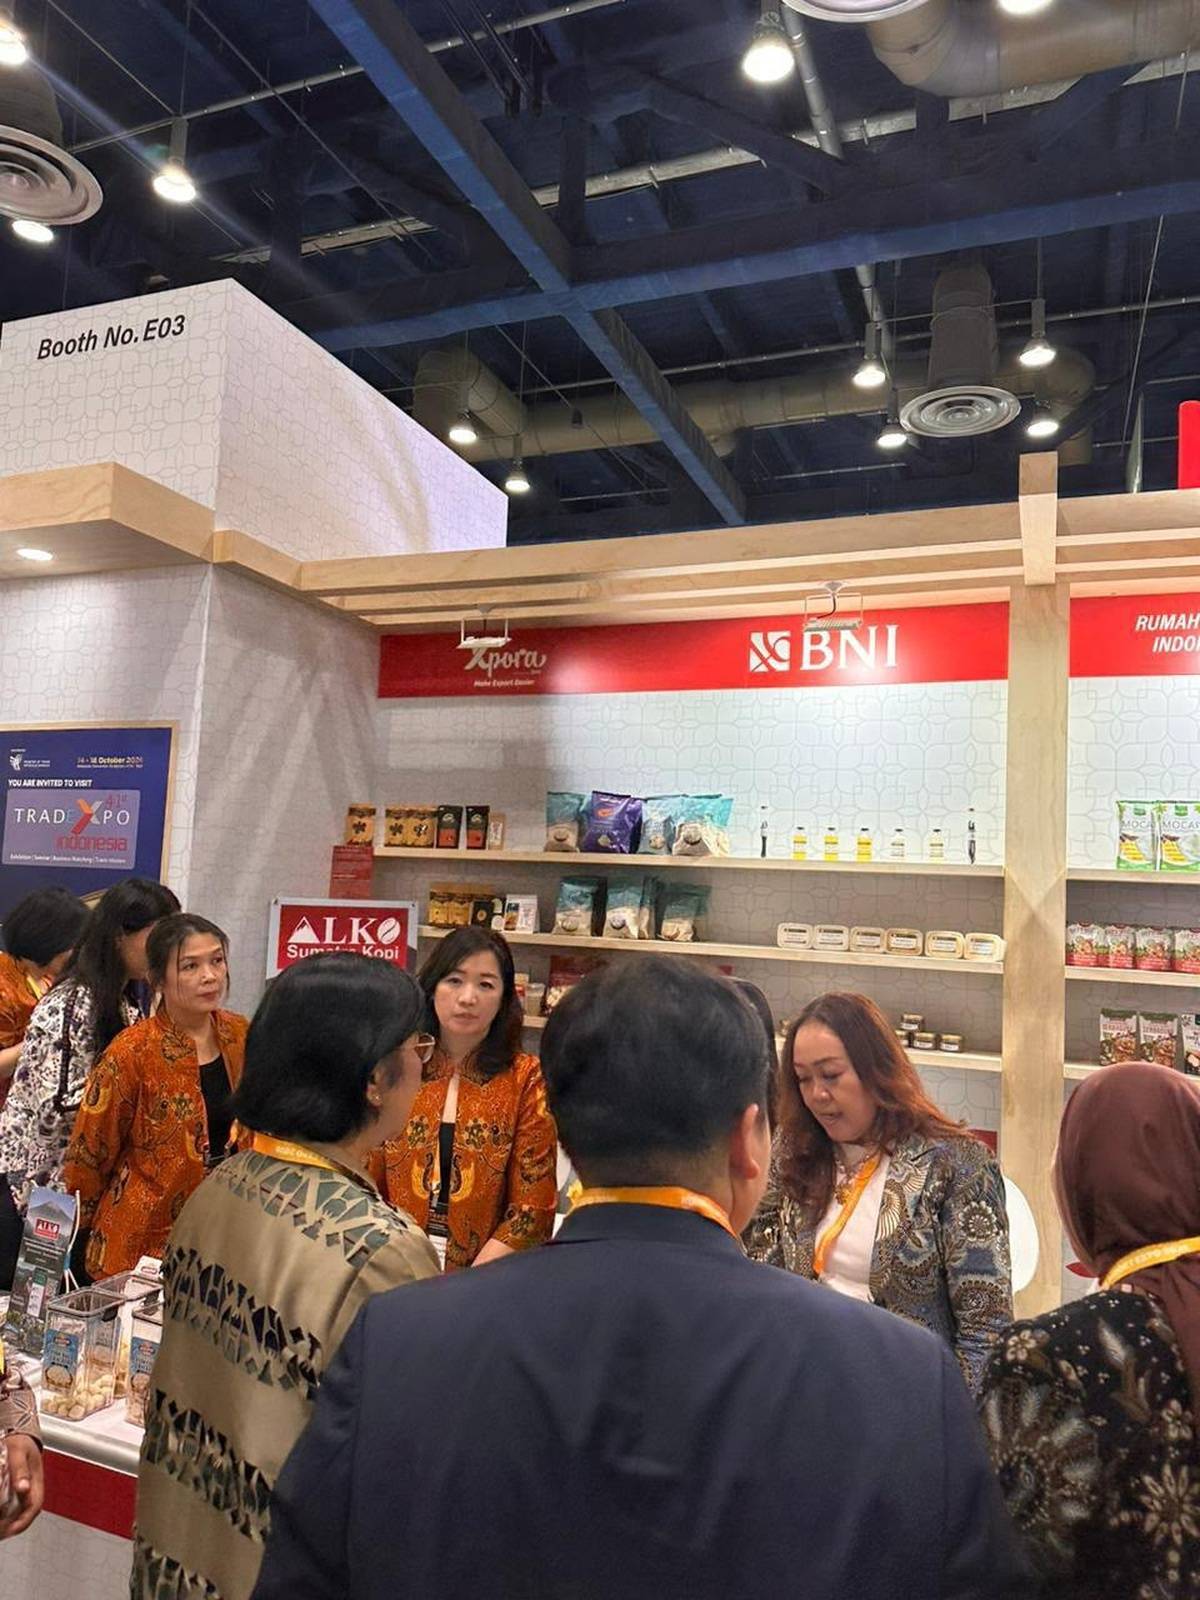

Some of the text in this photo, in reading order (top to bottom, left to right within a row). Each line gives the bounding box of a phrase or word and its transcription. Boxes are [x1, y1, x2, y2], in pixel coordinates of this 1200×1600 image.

[37, 314, 186, 360] Booth No. E03
[1135, 612, 1200, 632] RUMAH
[800, 623, 899, 671] BNI
[464, 647, 547, 678] Xpora
[98, 756, 125, 765] October
[8, 779, 93, 787] YOU ARE INVITED TO VISIT
